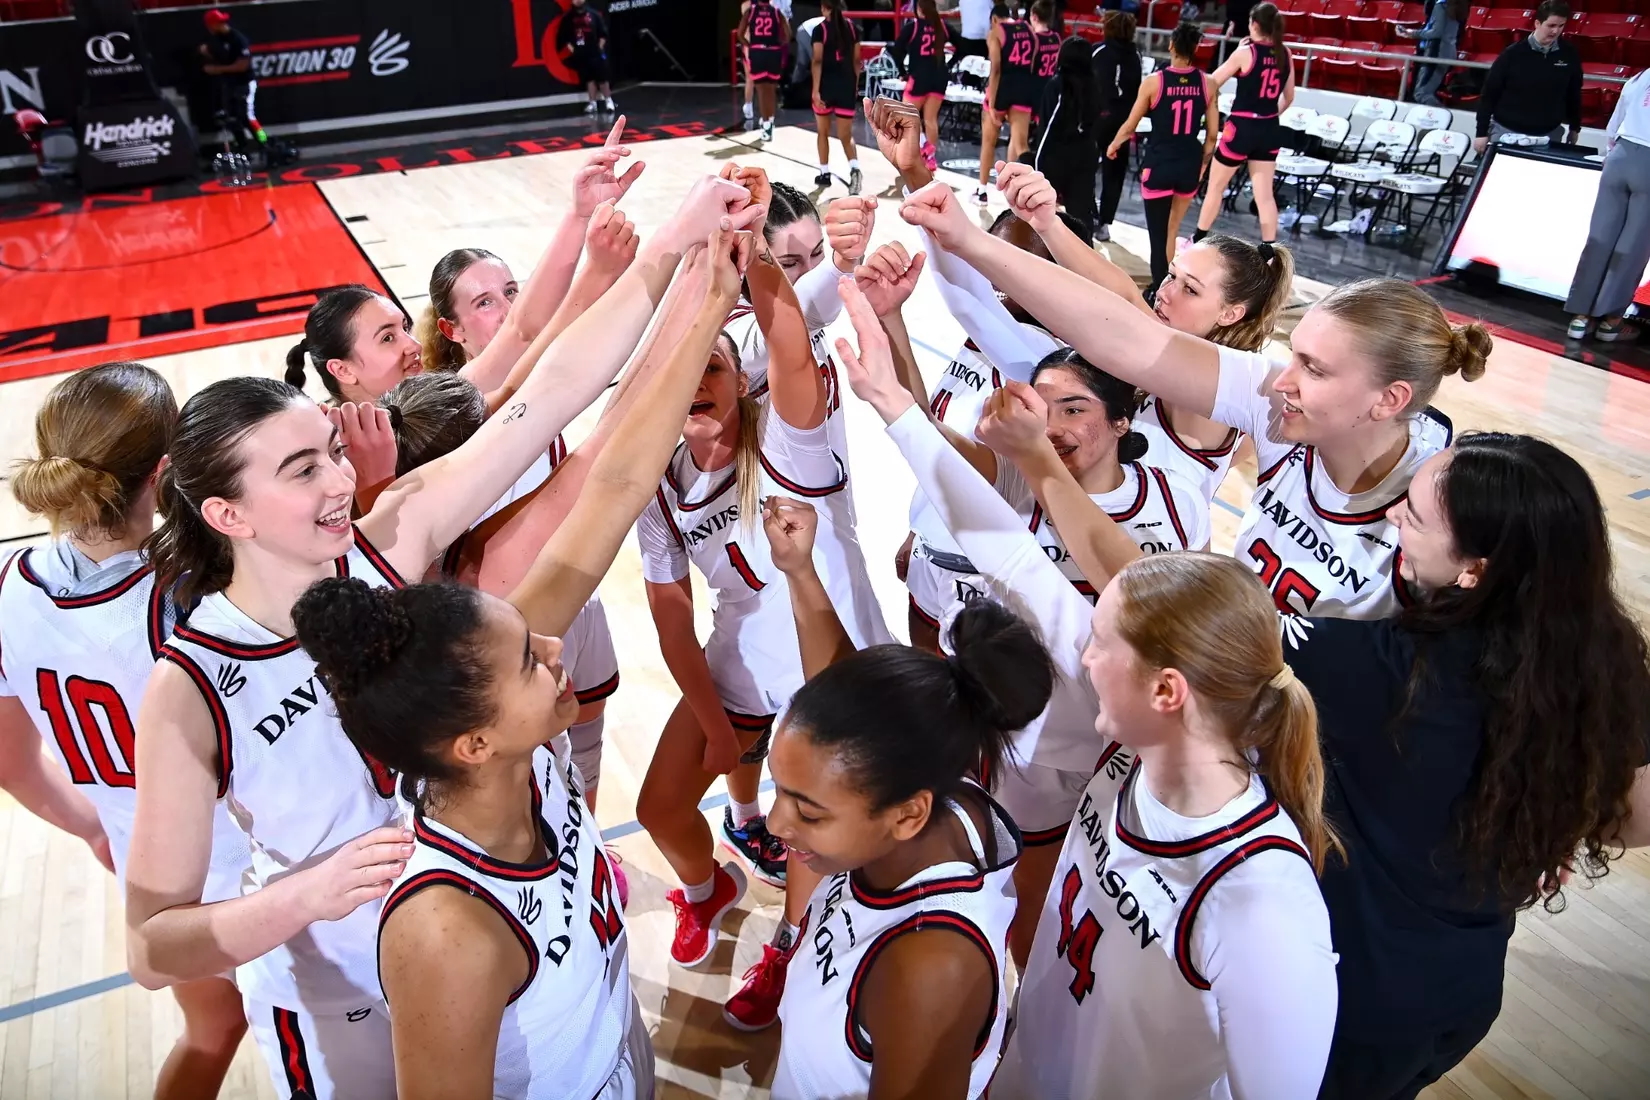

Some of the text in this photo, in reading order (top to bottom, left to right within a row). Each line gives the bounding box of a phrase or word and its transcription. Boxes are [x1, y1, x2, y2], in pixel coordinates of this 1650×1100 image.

[755, 17, 772, 36] 22
[327, 46, 356, 70] 30
[920, 35, 936, 56] 2
[1008, 40, 1031, 65] 42
[1038, 54, 1059, 76] 32
[1166, 86, 1201, 96] MITCHELL
[1259, 68, 1281, 98] 15
[1171, 99, 1193, 134] 11
[84, 114, 174, 151] Hendrick
[1134, 521, 1163, 529] A10
[1353, 526, 1393, 550] A10
[725, 540, 769, 592] 1
[36, 666, 136, 790] 10
[1148, 868, 1177, 904] A10
[840, 906, 856, 949] A10
